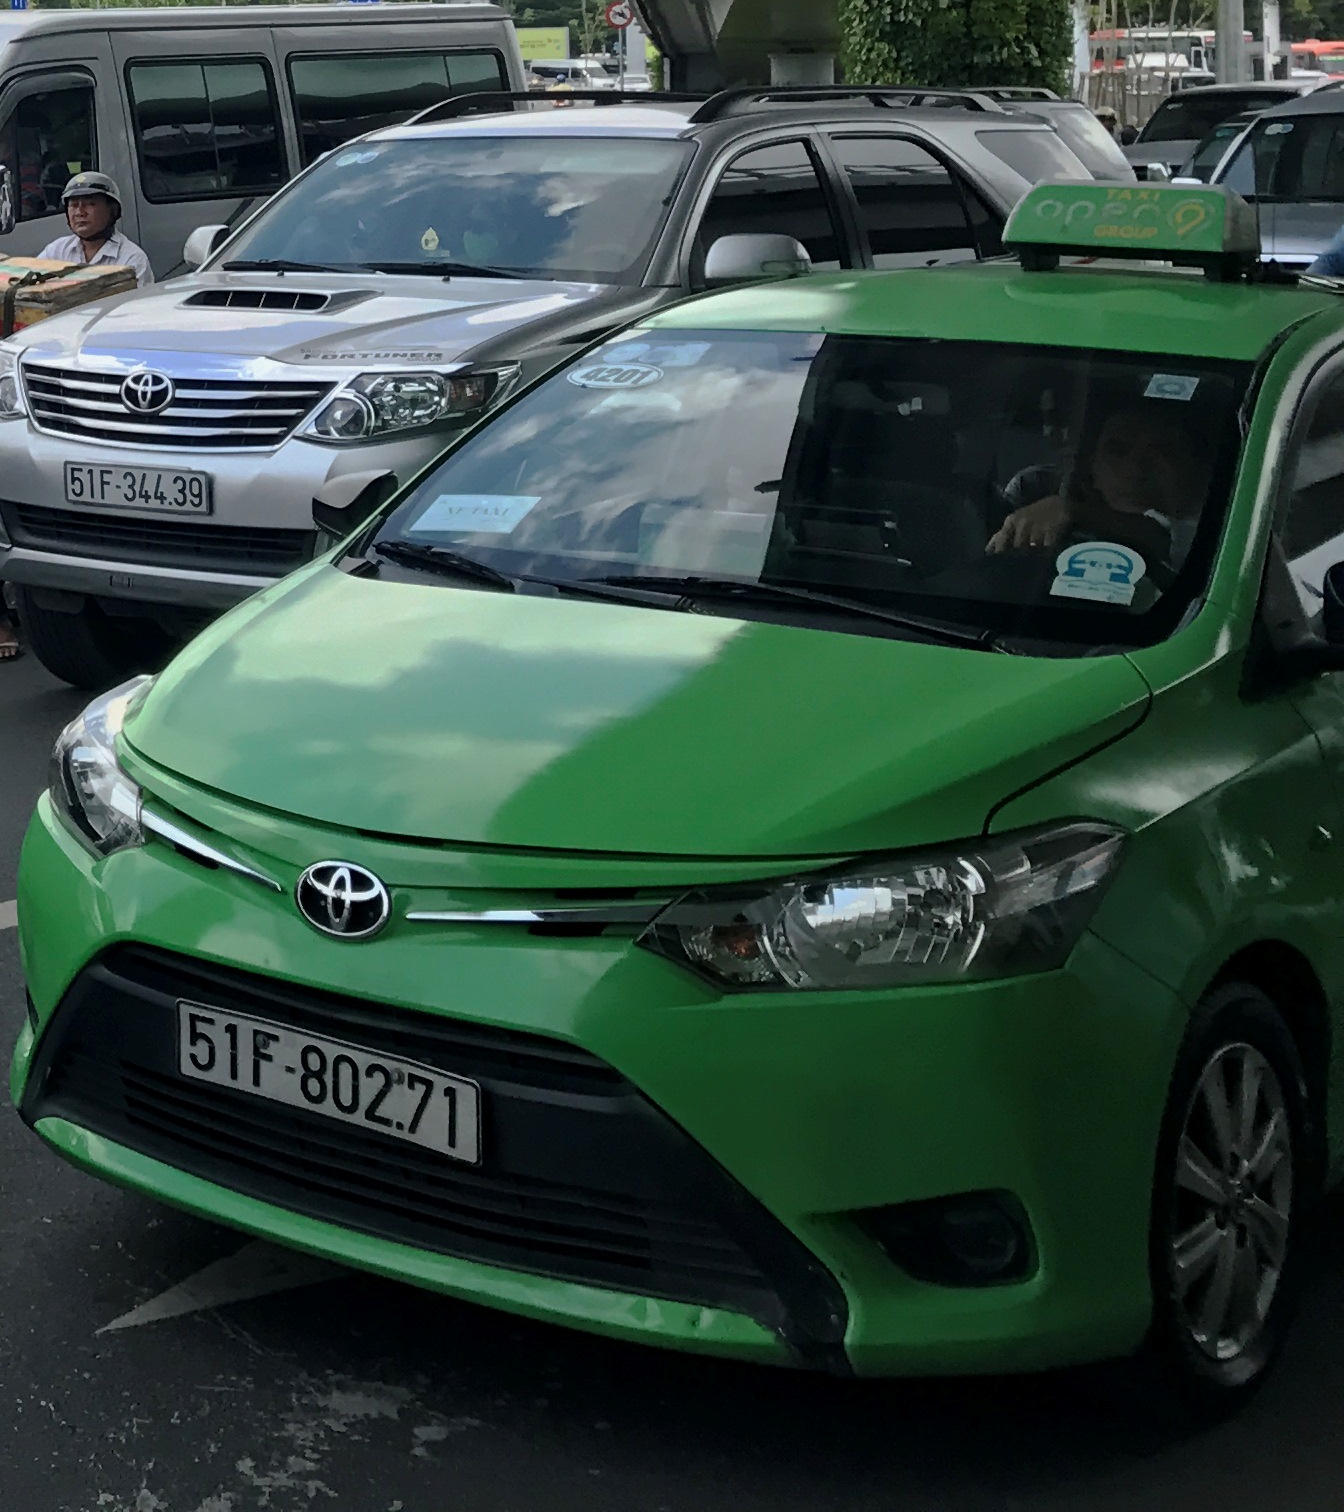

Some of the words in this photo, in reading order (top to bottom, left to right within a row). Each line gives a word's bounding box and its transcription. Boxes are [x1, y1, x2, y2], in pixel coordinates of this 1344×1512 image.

[1107, 189, 1160, 201] TAXI
[1093, 225, 1159, 238] GROUP
[303, 352, 443, 360] FORTUNER
[580, 367, 653, 384] 4201
[69, 466, 204, 508] 51F-344.39
[188, 1012, 457, 1150] 51F-802.71
